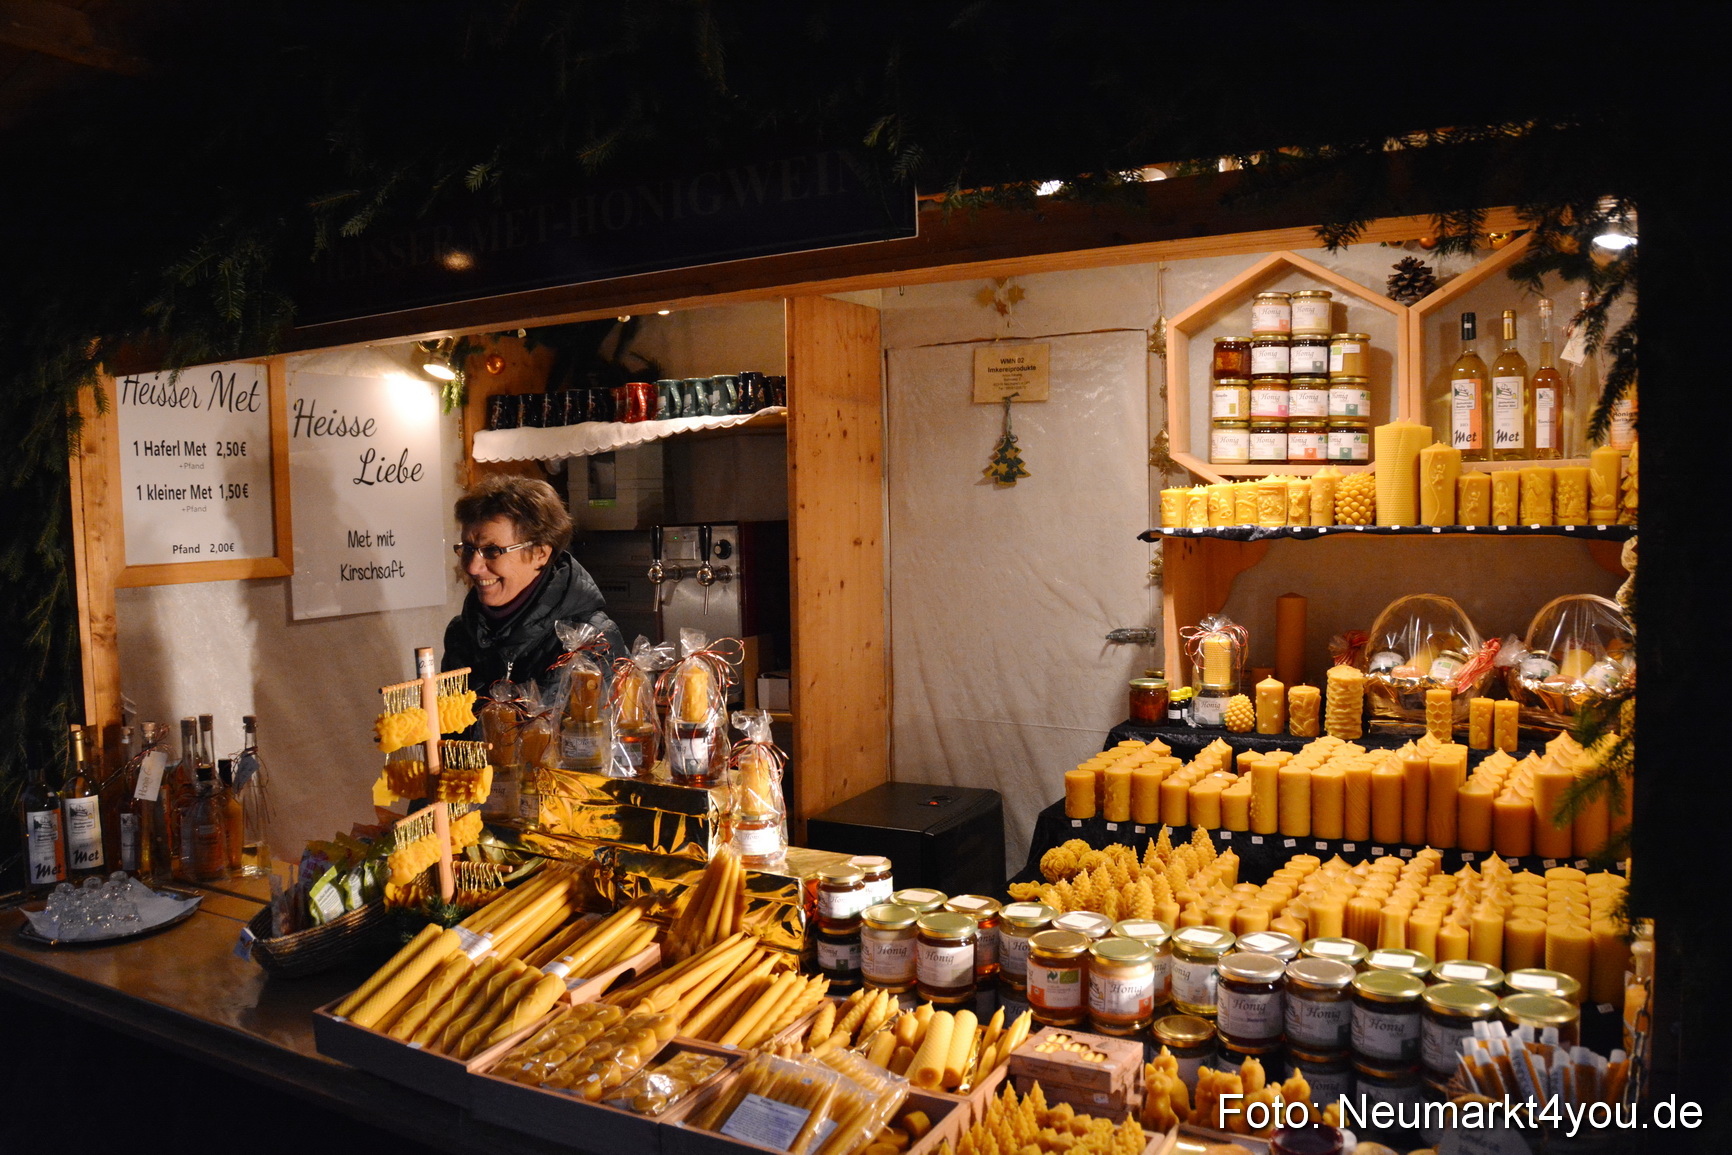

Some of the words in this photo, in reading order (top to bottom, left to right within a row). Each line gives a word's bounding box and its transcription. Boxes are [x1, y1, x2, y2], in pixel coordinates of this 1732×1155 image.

[1262, 308, 1281, 318] Honig
[988, 365, 1037, 373] Imkereiprodukte
[122, 374, 203, 409] Heisser
[207, 369, 262, 413] Met
[293, 398, 378, 438] Heisse
[1454, 429, 1478, 445] Met
[1495, 428, 1520, 445] Met
[133, 440, 139, 456] 1
[144, 440, 180, 457] Haferl
[184, 440, 207, 457] Met
[216, 441, 247, 459] 2,50€
[353, 447, 425, 486] Liebe
[136, 484, 142, 501] 1
[147, 483, 187, 501] kleiner
[190, 484, 213, 500] Met
[218, 483, 249, 502] 1,50€
[347, 529, 372, 549] Met
[376, 529, 396, 548] mit
[172, 543, 200, 555] Pfand
[209, 542, 235, 554] 2,00€
[340, 559, 406, 582] Kirschsaft
[1201, 700, 1221, 710] Honig
[73, 850, 100, 866] Met
[35, 863, 62, 880] Met
[877, 943, 908, 957] Honig
[925, 950, 955, 965] Honig
[1110, 982, 1143, 996] Honig
[1233, 998, 1267, 1015] Honig
[1306, 1006, 1342, 1022] Honig
[1369, 1018, 1406, 1034] Honig
